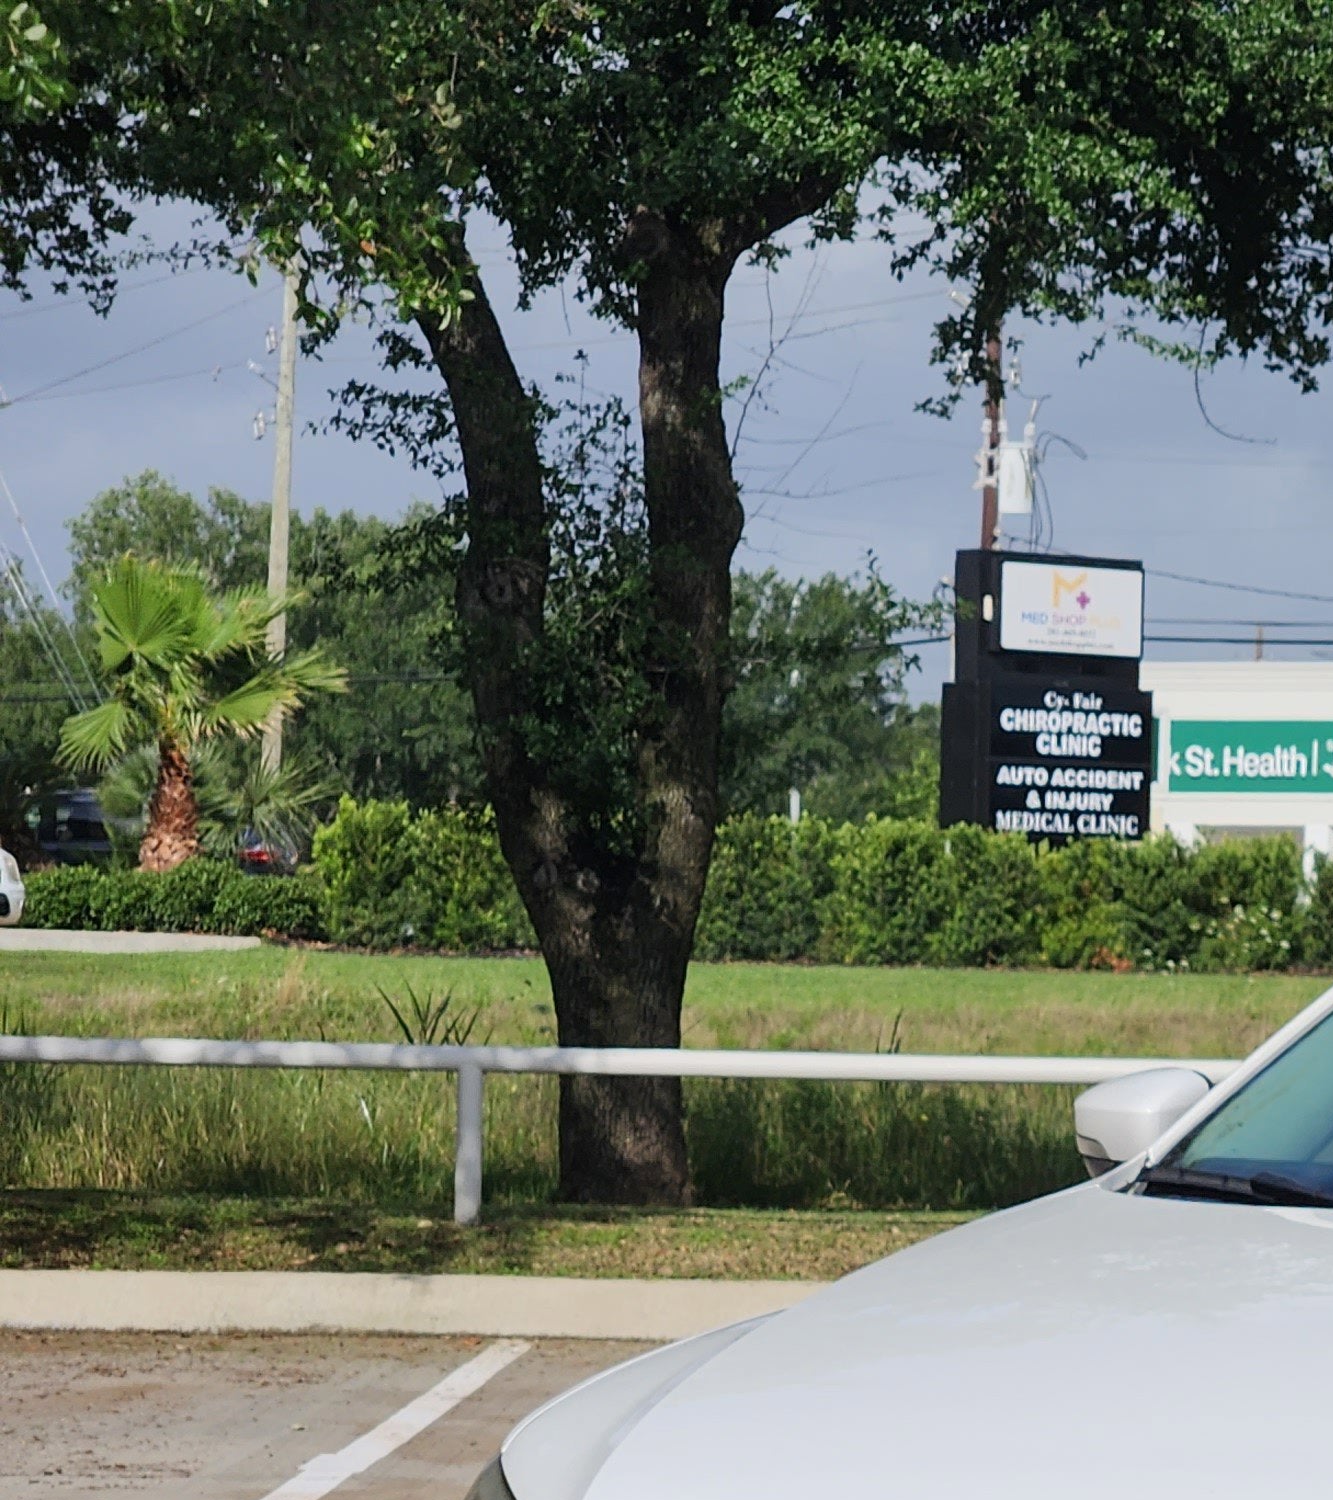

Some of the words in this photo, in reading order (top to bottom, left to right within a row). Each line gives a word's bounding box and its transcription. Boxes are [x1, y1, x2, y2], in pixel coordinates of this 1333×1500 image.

[1000, 708, 1142, 737] CHIROPRACTIC
[1035, 733, 1101, 757] CLINIC
[1185, 744, 1220, 777] St.
[1222, 744, 1307, 777] Health
[996, 765, 1049, 787] AUTO
[1050, 768, 1144, 790] ACCIDENT
[1026, 789, 1041, 809] &
[1044, 790, 1114, 812] INJURY
[996, 809, 1075, 833] MEDICAL
[1077, 813, 1139, 836] CLINIC
